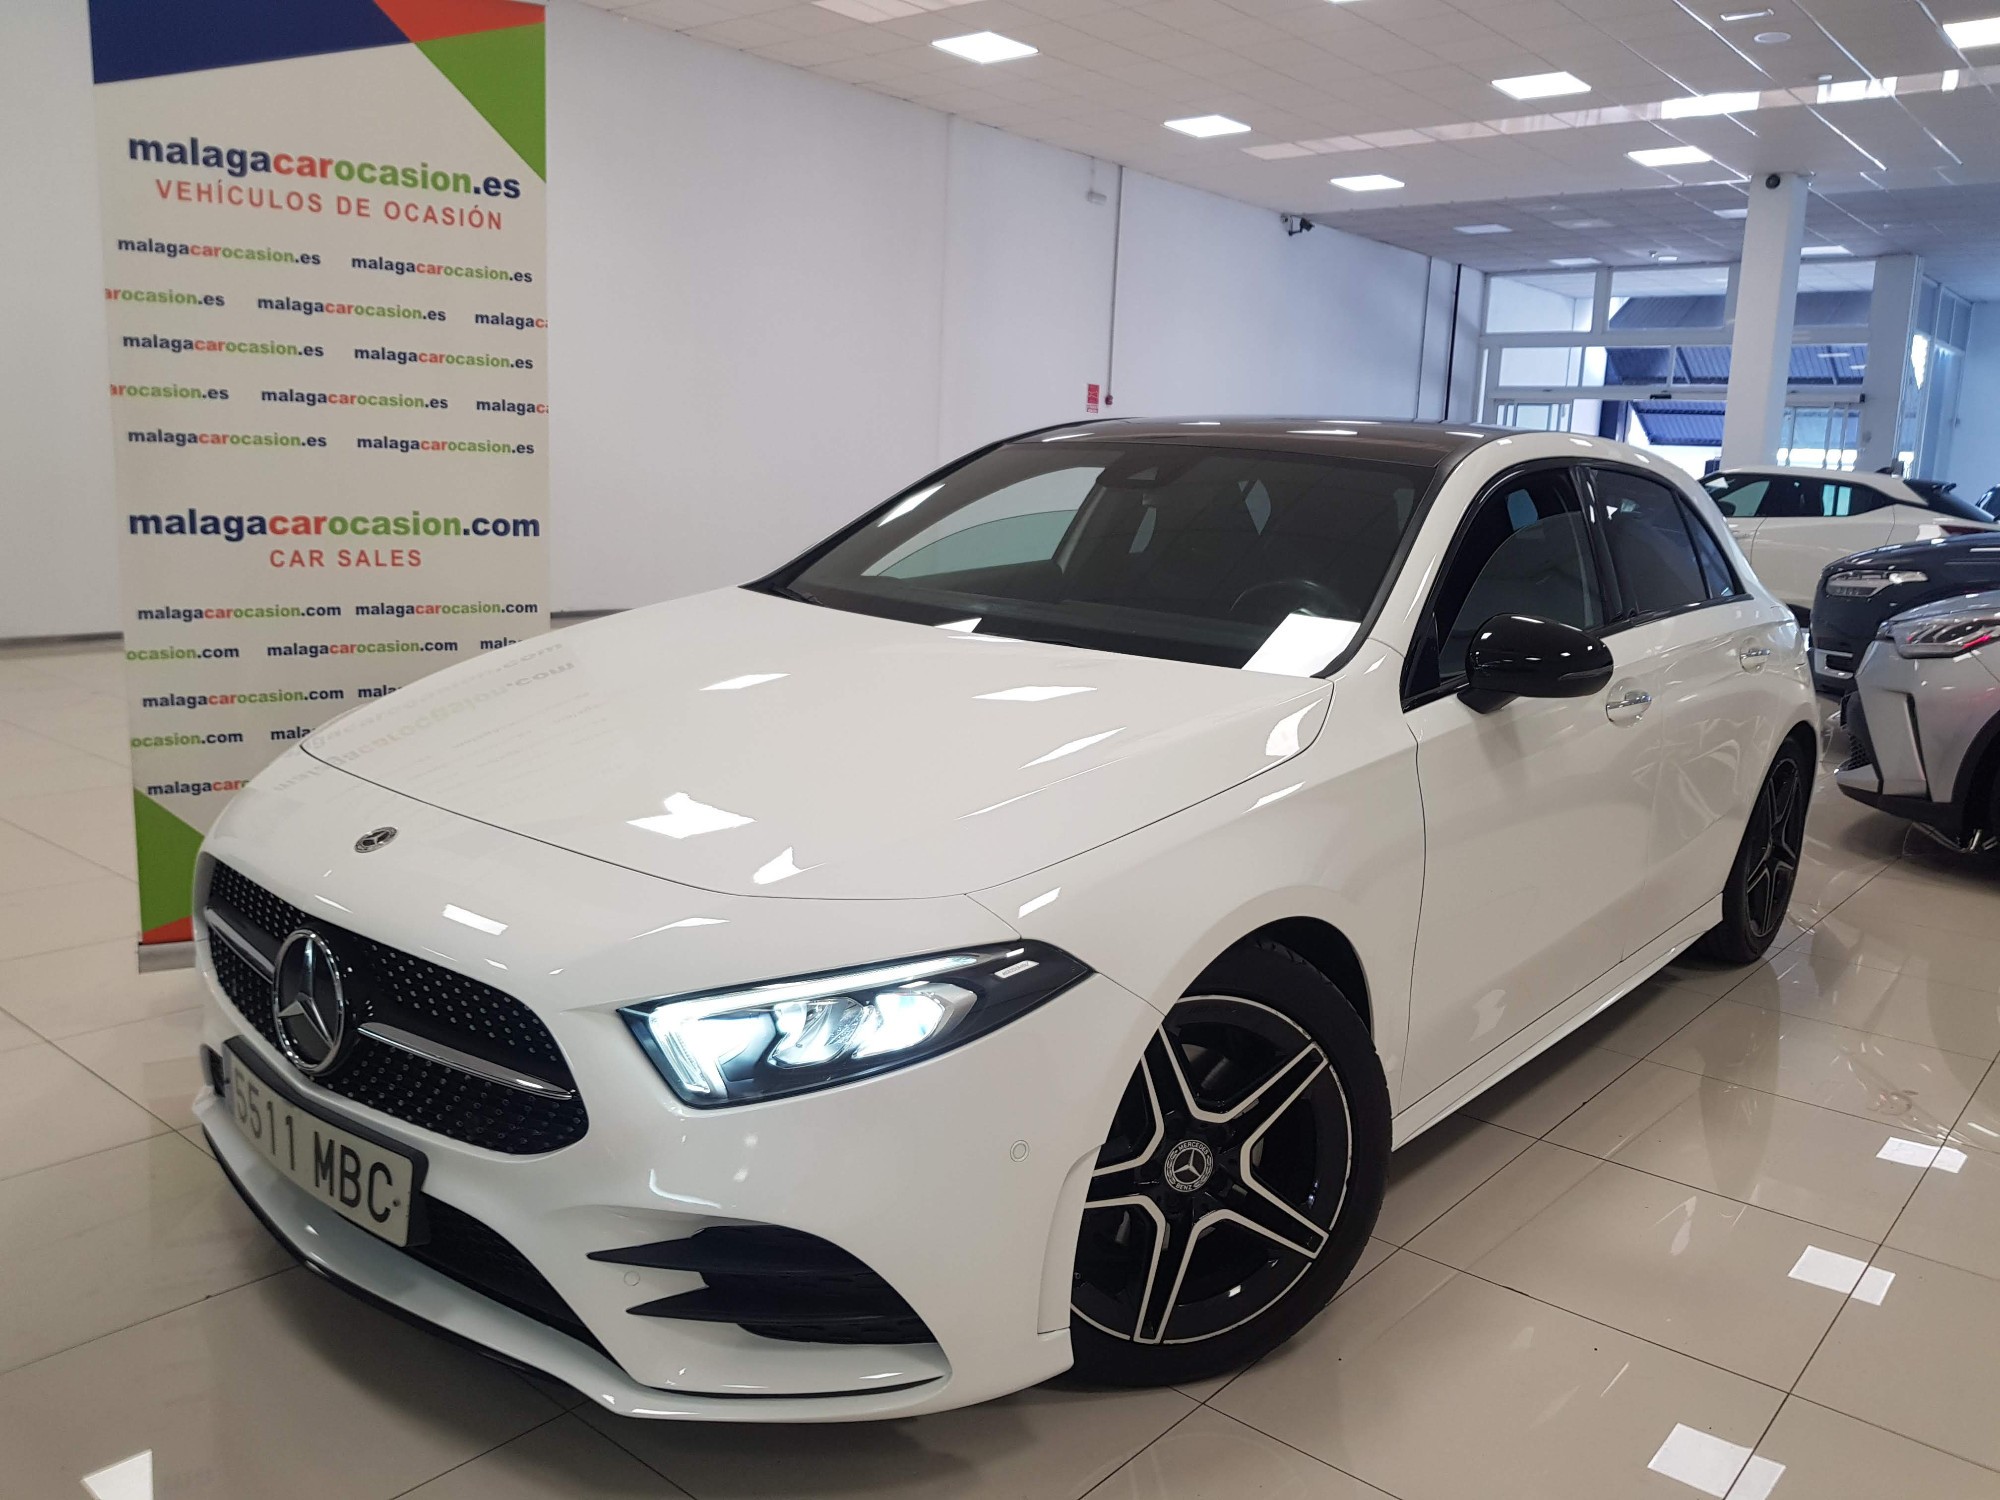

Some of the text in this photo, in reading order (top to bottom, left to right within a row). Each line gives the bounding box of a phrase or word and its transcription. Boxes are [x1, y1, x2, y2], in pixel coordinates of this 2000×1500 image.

[128, 136, 522, 199] malagacarocasion.es
[155, 178, 502, 230] VEHÍCULOS DE OCASIÓN
[117, 237, 533, 284] malagacarocasion.es malagacarocasion.es
[257, 295, 446, 322] malagacarocasion.es
[122, 333, 533, 370] malagacarocasion.es malagacarocasion.es
[261, 388, 448, 410] malagacarocasion.es
[128, 428, 534, 455] malagacarocasion.es malagacarocasion.es
[128, 508, 540, 543] malagacarocasion.com
[270, 549, 422, 568] CAR SALES
[137, 600, 538, 623] malagacarocasion.com malagacarocasion.com
[126, 645, 240, 661] ocasion.com
[267, 640, 458, 658] malagacarocasion.com
[142, 689, 344, 709] malagacarocasion.com
[131, 731, 244, 748] ocasion.com
[234, 1068, 393, 1223] 5511 MBC
[1178, 1141, 1209, 1155] MERCEDES
[1175, 1182, 1193, 1190] BENZ
